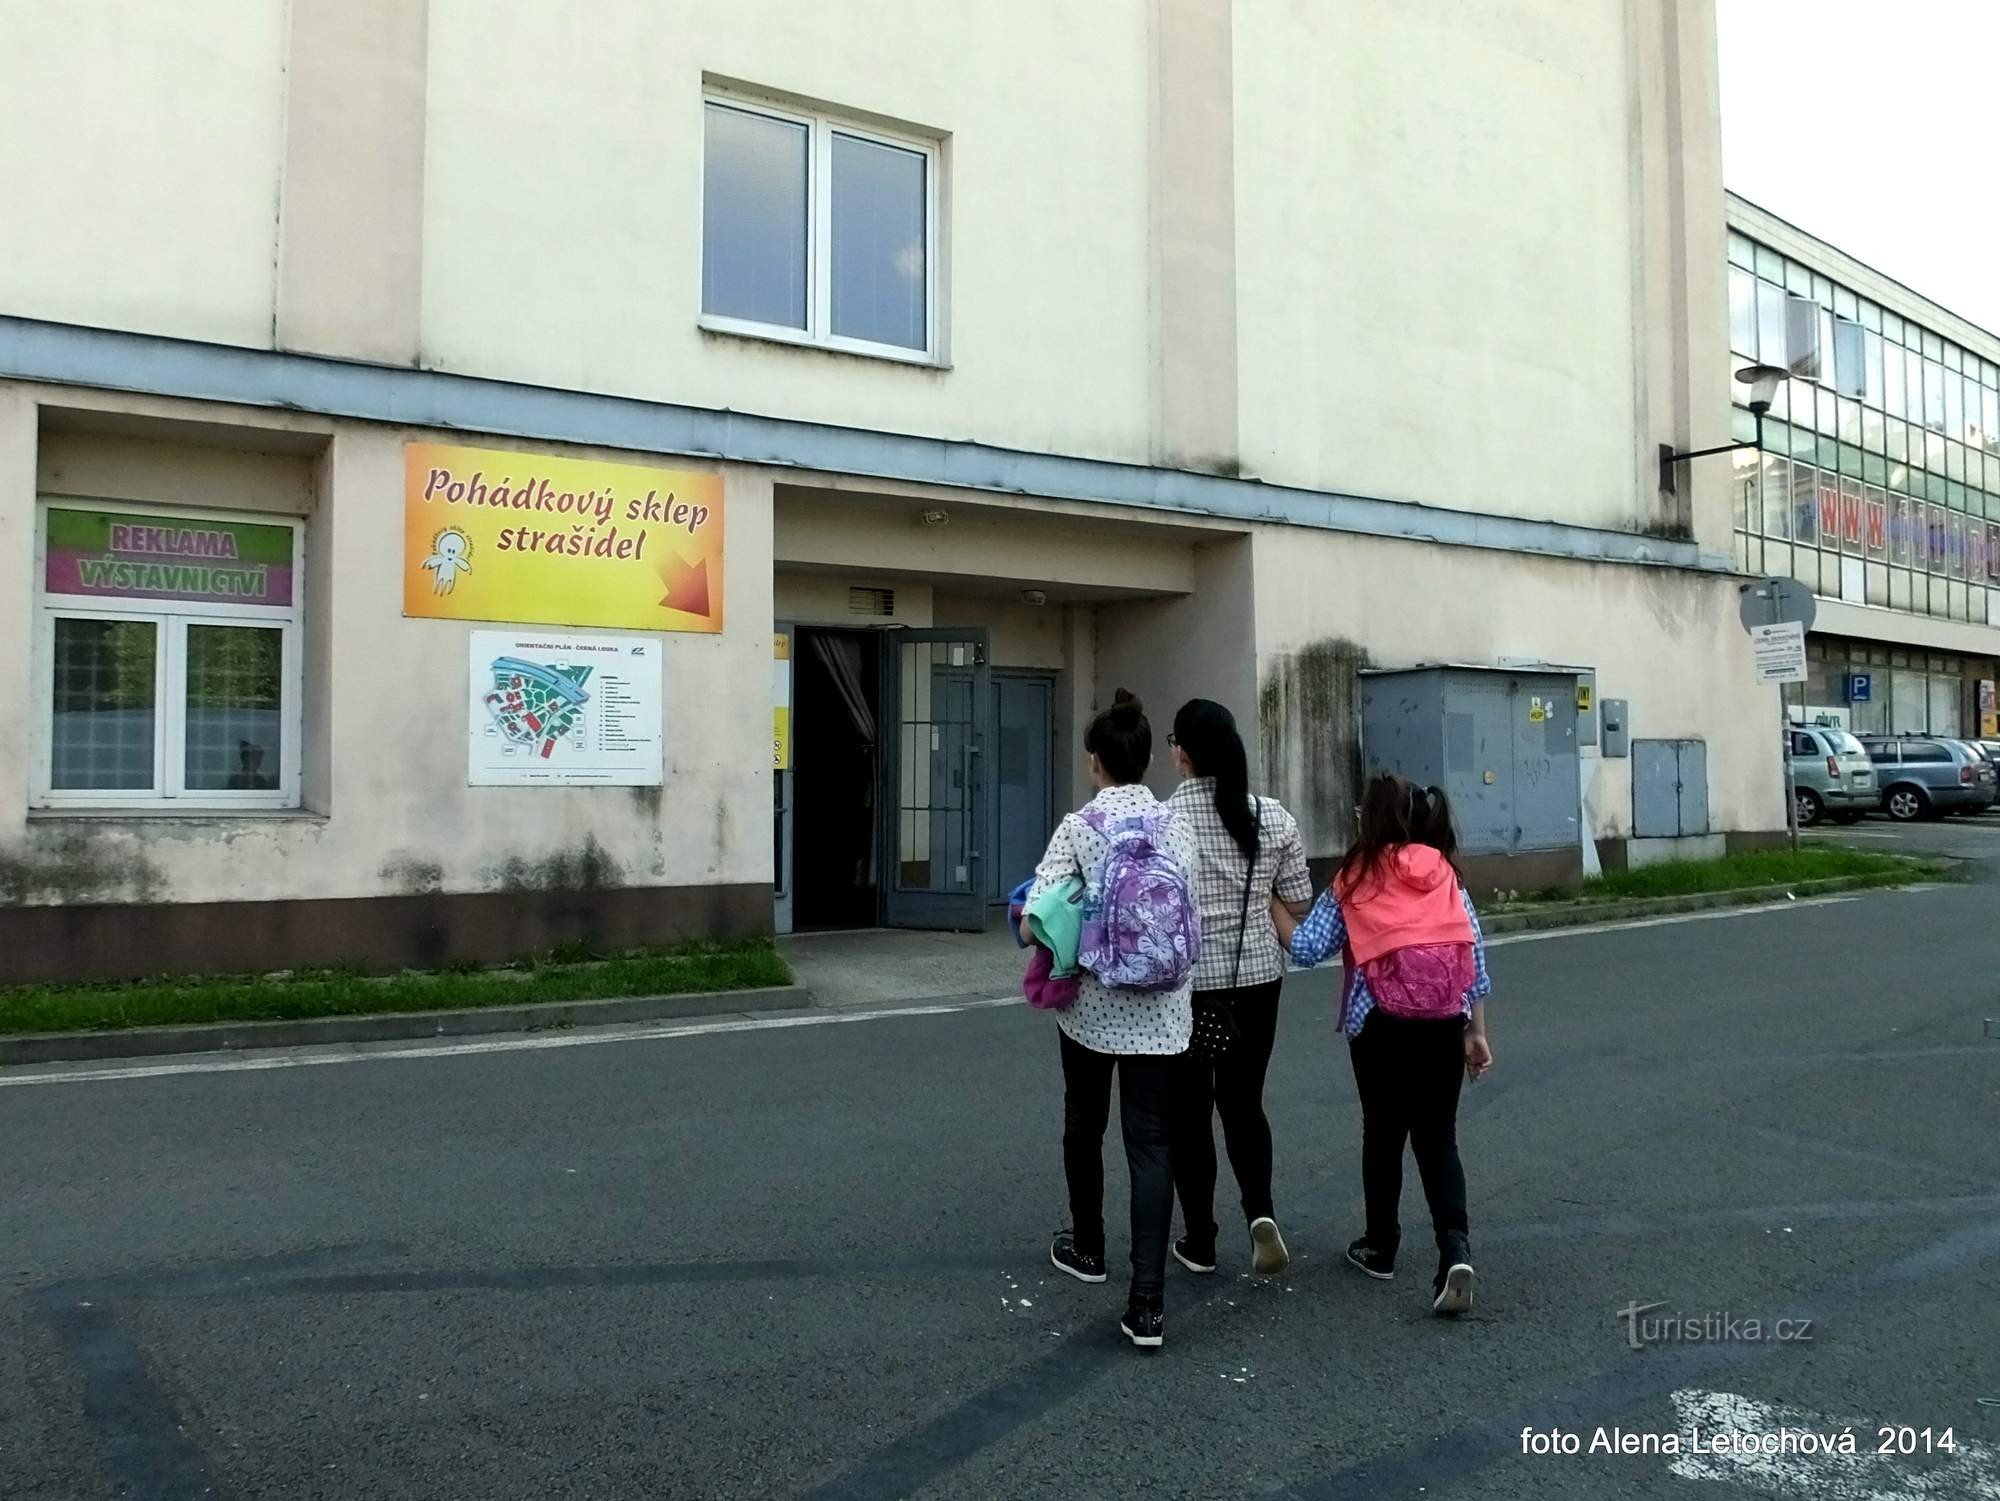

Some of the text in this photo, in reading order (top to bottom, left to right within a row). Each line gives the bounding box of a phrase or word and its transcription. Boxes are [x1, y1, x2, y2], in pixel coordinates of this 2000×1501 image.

[424, 467, 709, 534] Pohádkový sklep
[111, 525, 238, 558] REKLAMA
[496, 525, 648, 561] strašidel
[79, 555, 267, 596] VÝSTAVNICTVÍ
[1854, 677, 1868, 694] P
